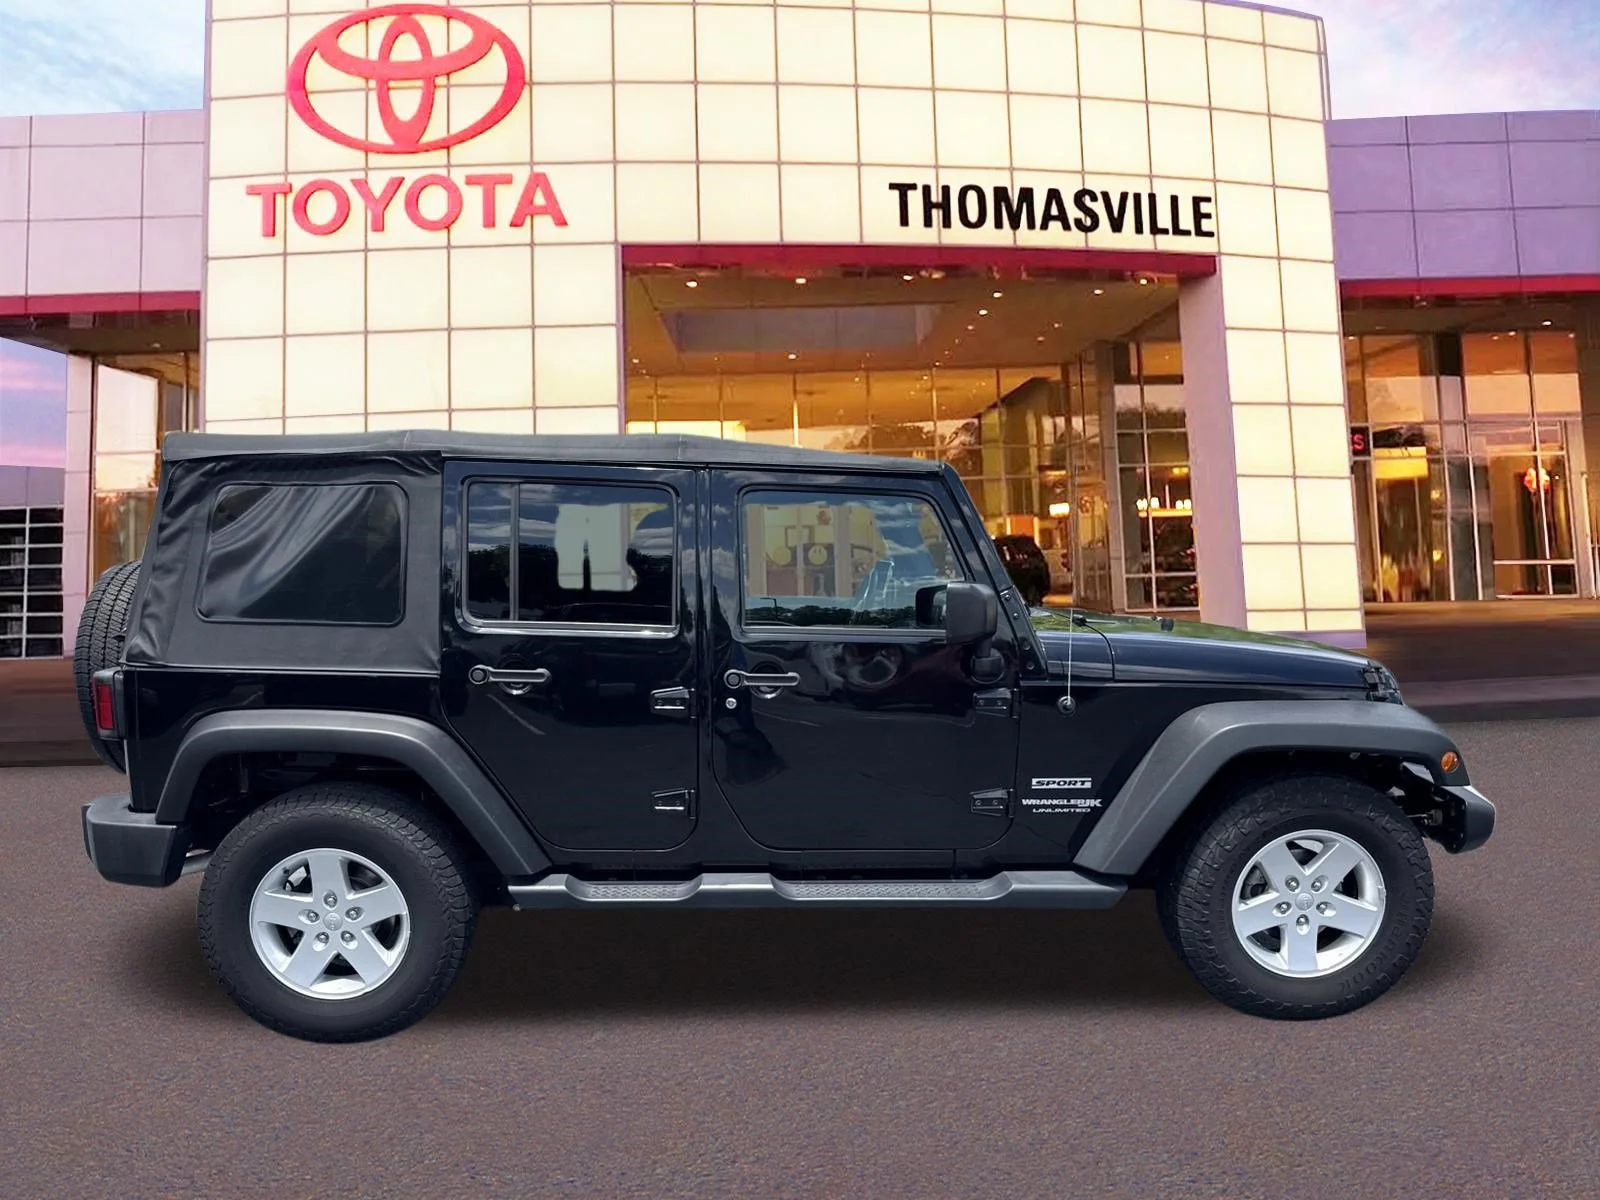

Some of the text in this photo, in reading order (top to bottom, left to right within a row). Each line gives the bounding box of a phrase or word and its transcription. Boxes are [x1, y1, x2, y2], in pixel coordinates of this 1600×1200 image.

[246, 172, 568, 237] TOYOTA
[888, 182, 1216, 238] THOMASVILLE
[1034, 779, 1091, 787] SPORT
